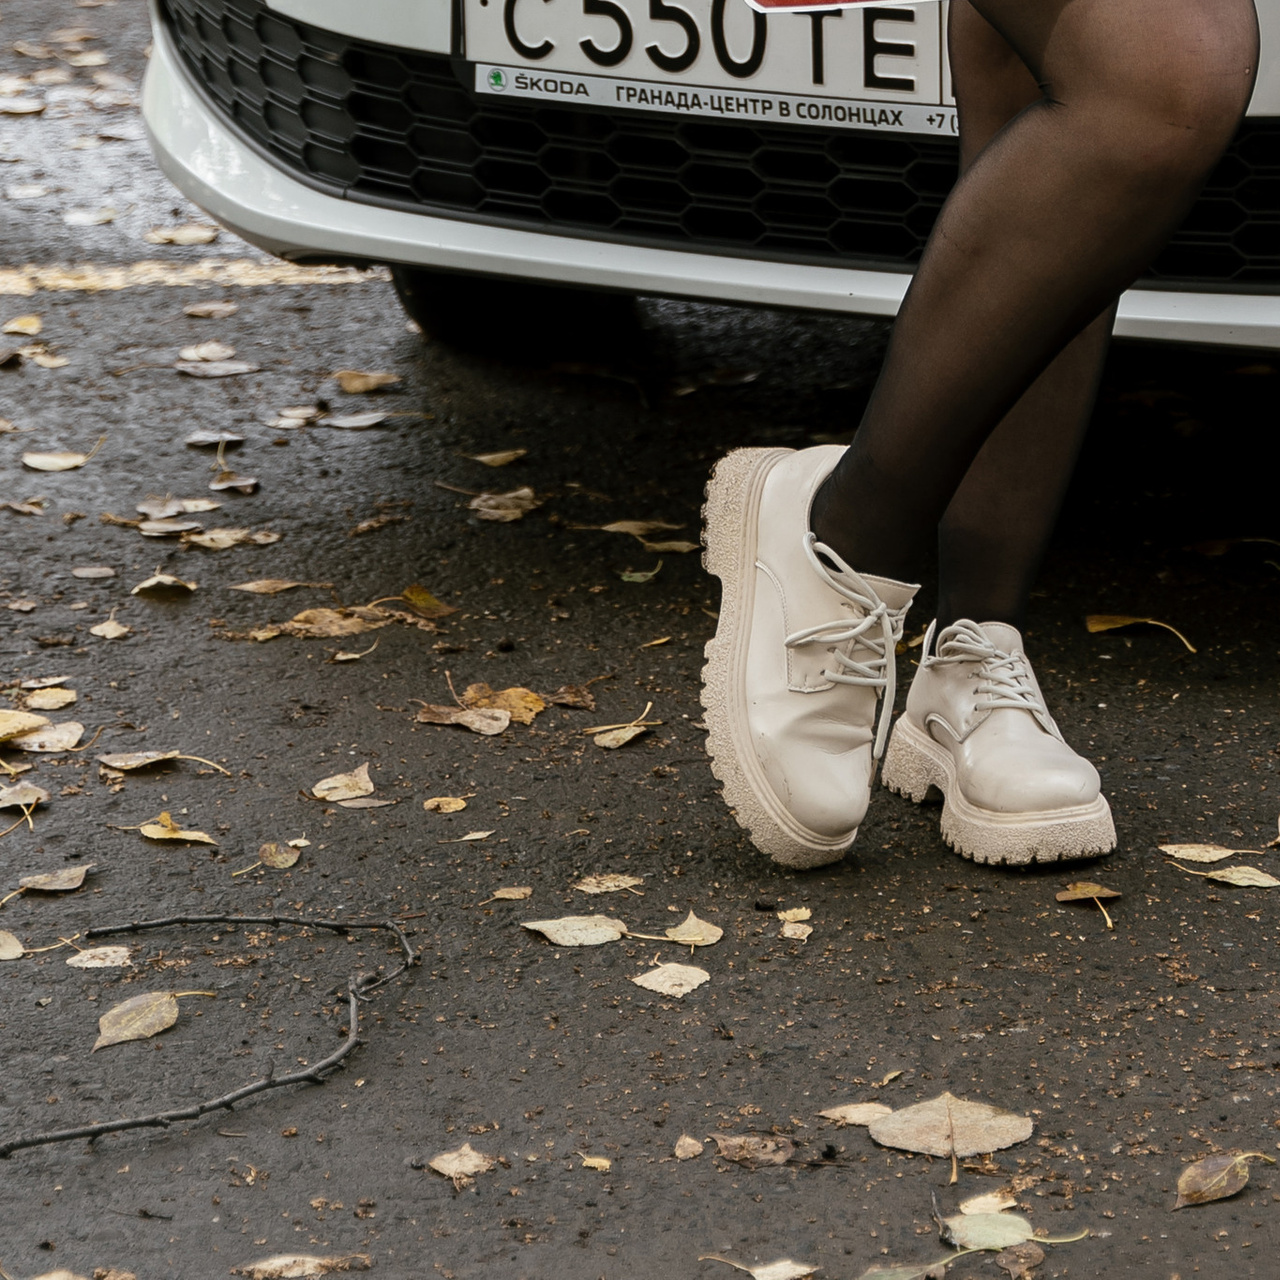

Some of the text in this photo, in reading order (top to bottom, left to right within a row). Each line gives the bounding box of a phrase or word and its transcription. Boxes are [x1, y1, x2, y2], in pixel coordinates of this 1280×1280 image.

[514, 73, 590, 97] ŠKODA
[615, 85, 773, 117] ГРАНАДА-ЦЕНТР
[779, 100, 791, 118] В
[796, 102, 904, 127] СОЛОНЦАХ
